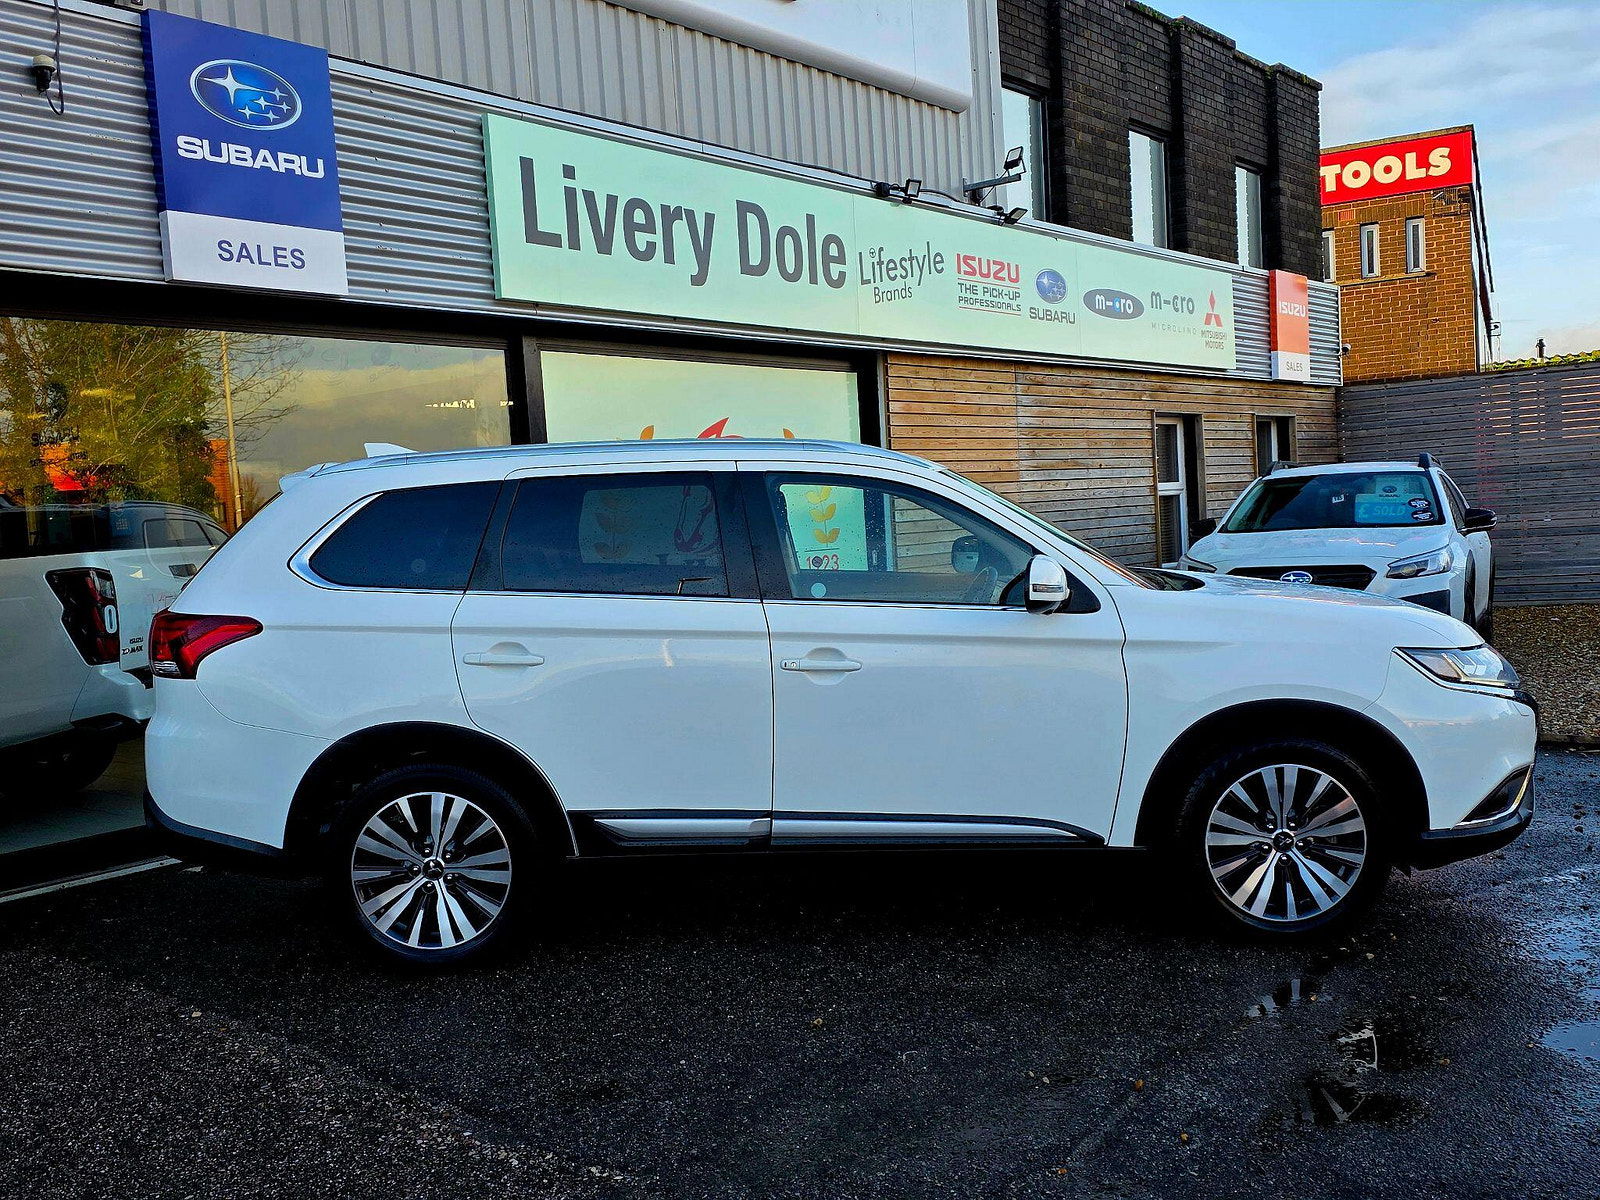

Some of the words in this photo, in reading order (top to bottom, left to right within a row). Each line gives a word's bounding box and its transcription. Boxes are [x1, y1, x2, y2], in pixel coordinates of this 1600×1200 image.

[177, 135, 325, 179] SUBARU
[1320, 147, 1452, 193] TOOLS
[519, 156, 716, 287] Livery
[736, 199, 847, 289] Dole
[217, 239, 306, 270] SALES
[858, 241, 945, 286] Lifestyle
[956, 253, 1020, 283] ISUZU
[873, 281, 913, 304] Brands
[957, 282, 979, 296] THE
[982, 286, 1021, 301] PICK-UP
[958, 296, 1021, 311] PROFESSIONALS
[1279, 301, 1306, 317] ISUZU
[1029, 307, 1075, 325] SUBARU
[1151, 322, 1197, 336] MICROLINO
[1201, 329, 1228, 341] MITSUBISHI
[1205, 340, 1225, 350] MOTORS
[1286, 361, 1303, 372] SALES
